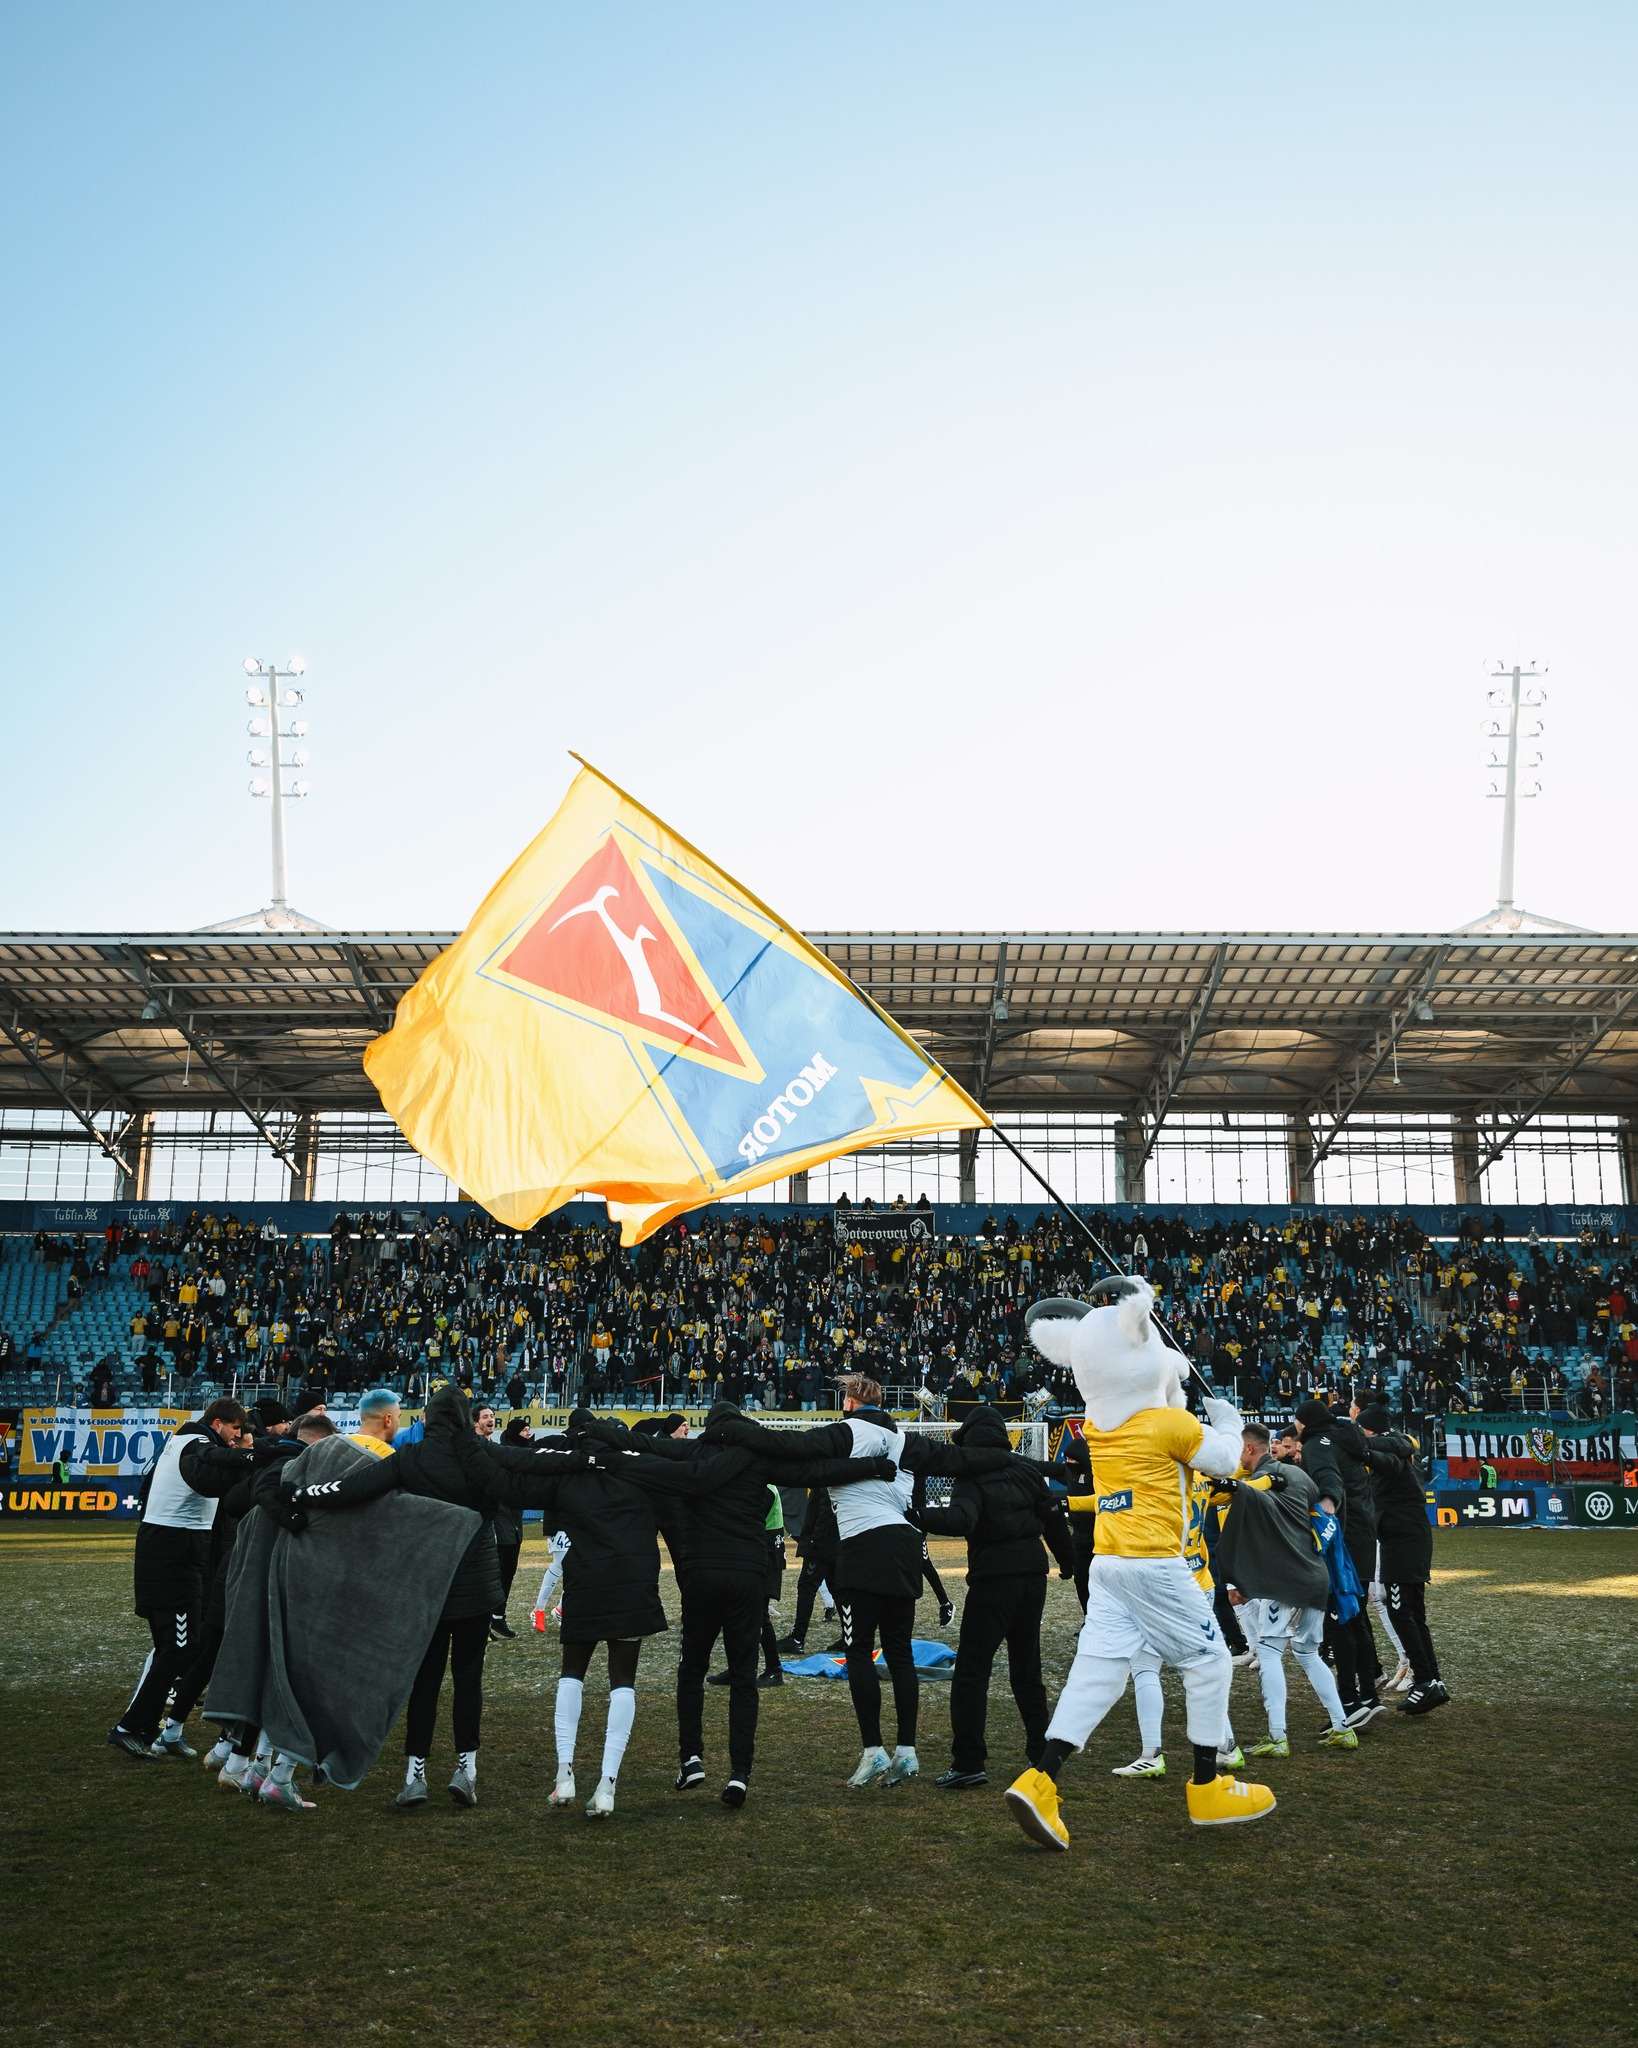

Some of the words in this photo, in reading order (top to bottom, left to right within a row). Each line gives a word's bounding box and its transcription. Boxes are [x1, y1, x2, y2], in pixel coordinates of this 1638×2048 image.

[79, 1418, 138, 1426] WSCHODNICH
[1455, 1428, 1524, 1462] TYLKO
[8, 1490, 118, 1511] UNITED
[1463, 1497, 1497, 1518] +3
